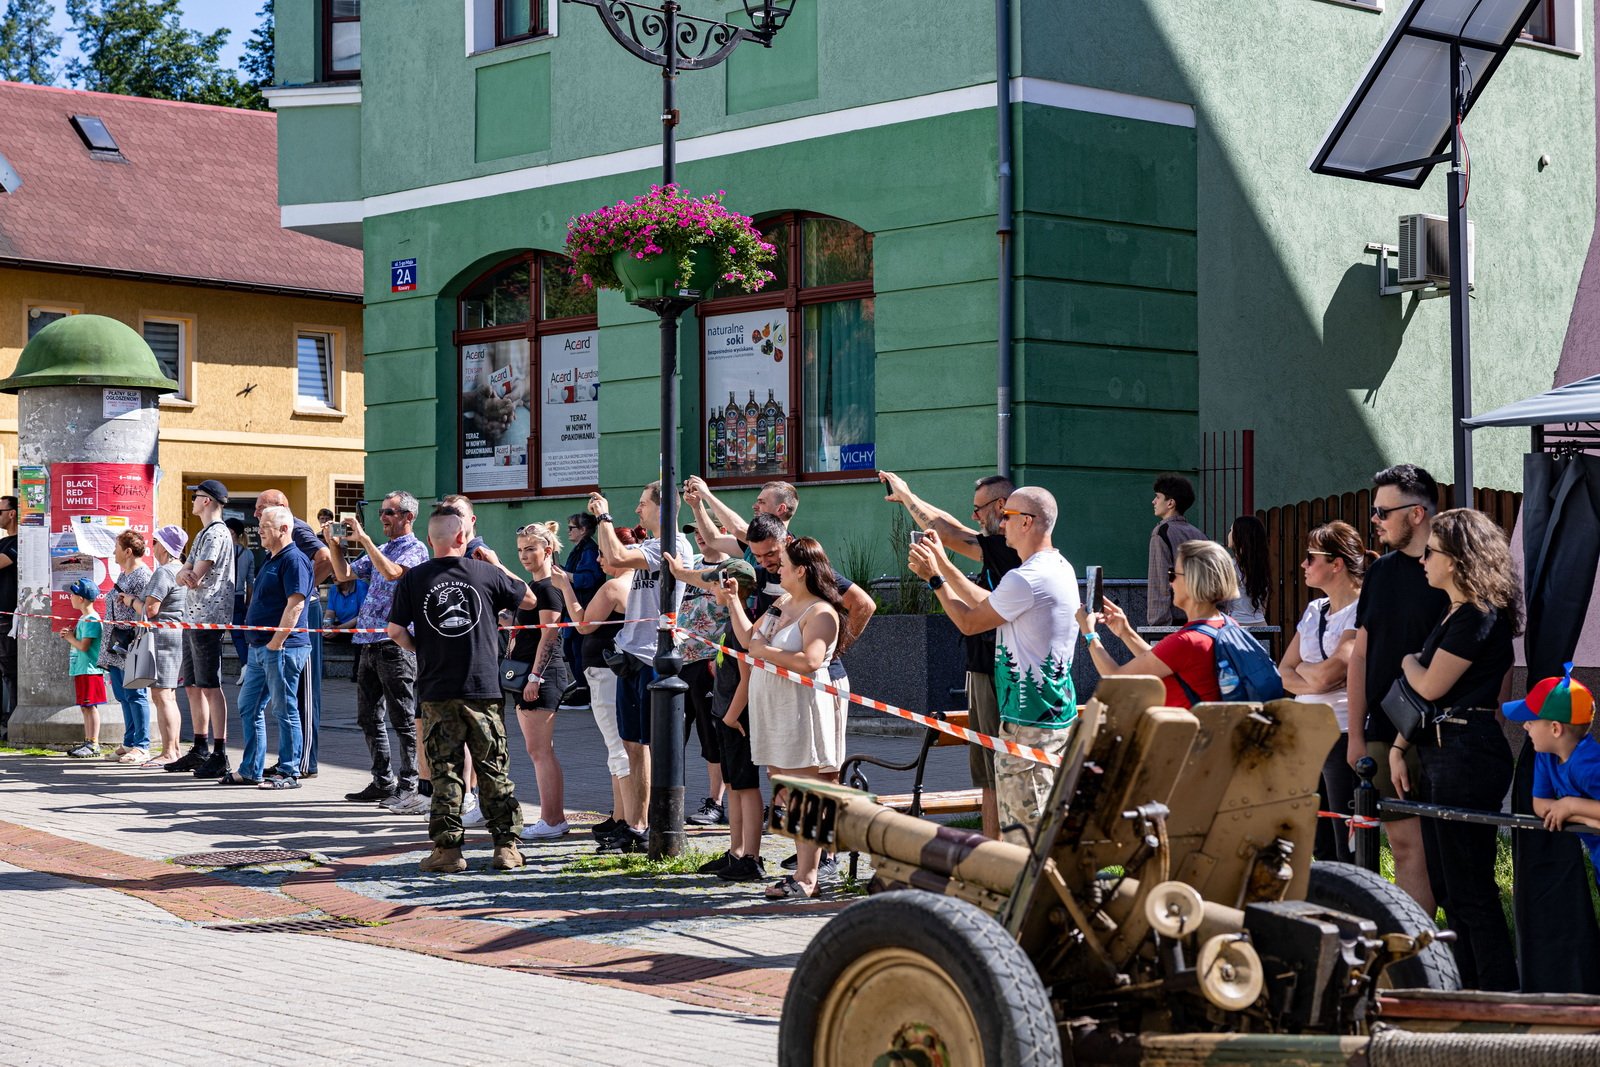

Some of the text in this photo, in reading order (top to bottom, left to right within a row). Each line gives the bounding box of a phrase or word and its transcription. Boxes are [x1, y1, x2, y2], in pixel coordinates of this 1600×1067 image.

[397, 269, 411, 285] 2A
[707, 323, 744, 336] naturalne
[564, 336, 590, 351] Acard
[726, 334, 744, 346] soki
[465, 350, 485, 360] Acard
[490, 367, 508, 385] Acard
[550, 370, 572, 384] Acard
[569, 413, 587, 422] TERAZ
[571, 422, 592, 431] NOWYM
[841, 450, 875, 463] VICHY
[66, 480, 94, 488] BLACK
[66, 489, 84, 497] RED
[66, 497, 94, 506] WHITE
